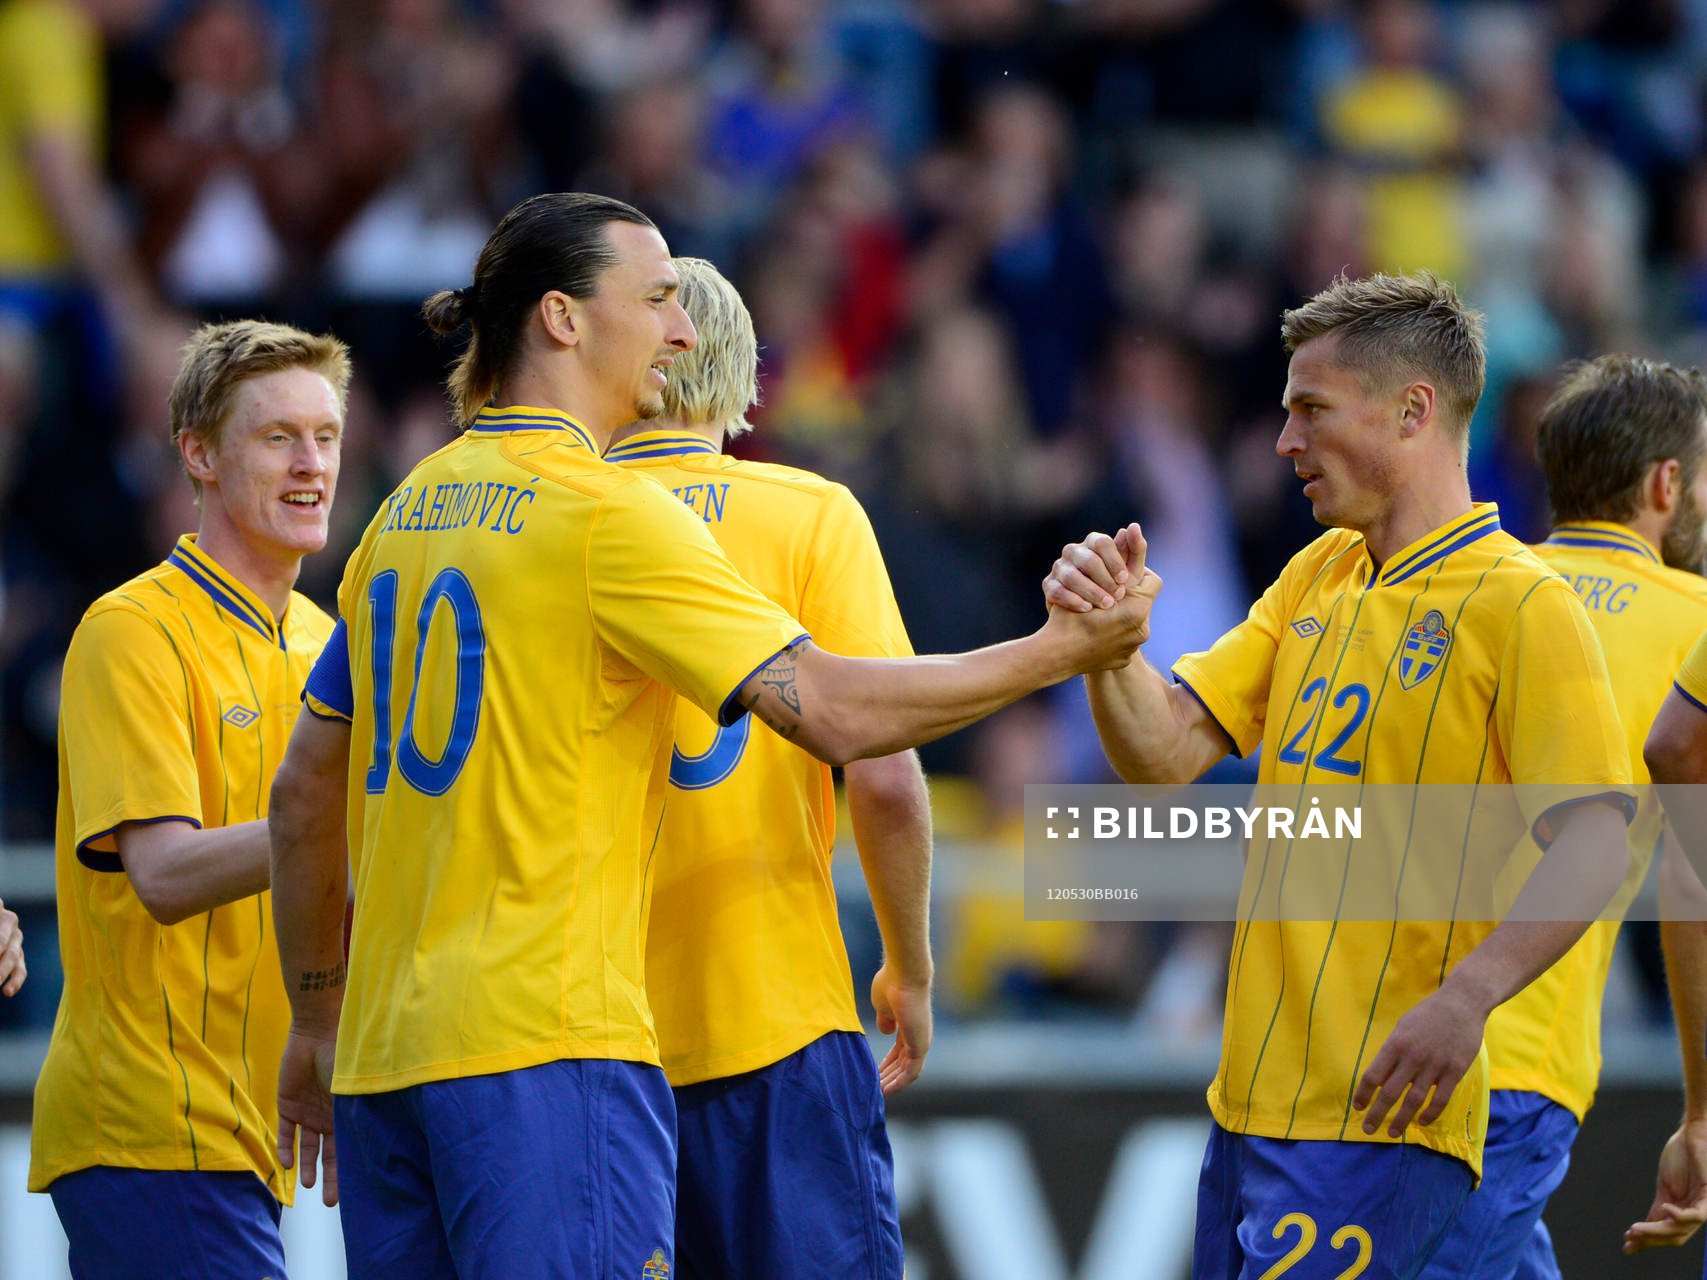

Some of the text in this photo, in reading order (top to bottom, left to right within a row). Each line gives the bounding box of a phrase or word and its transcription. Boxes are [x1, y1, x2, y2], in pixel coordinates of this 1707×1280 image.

[381, 477, 540, 534] RAHIMOVIĆ
[366, 567, 486, 796] 10
[1279, 677, 1370, 776] 22
